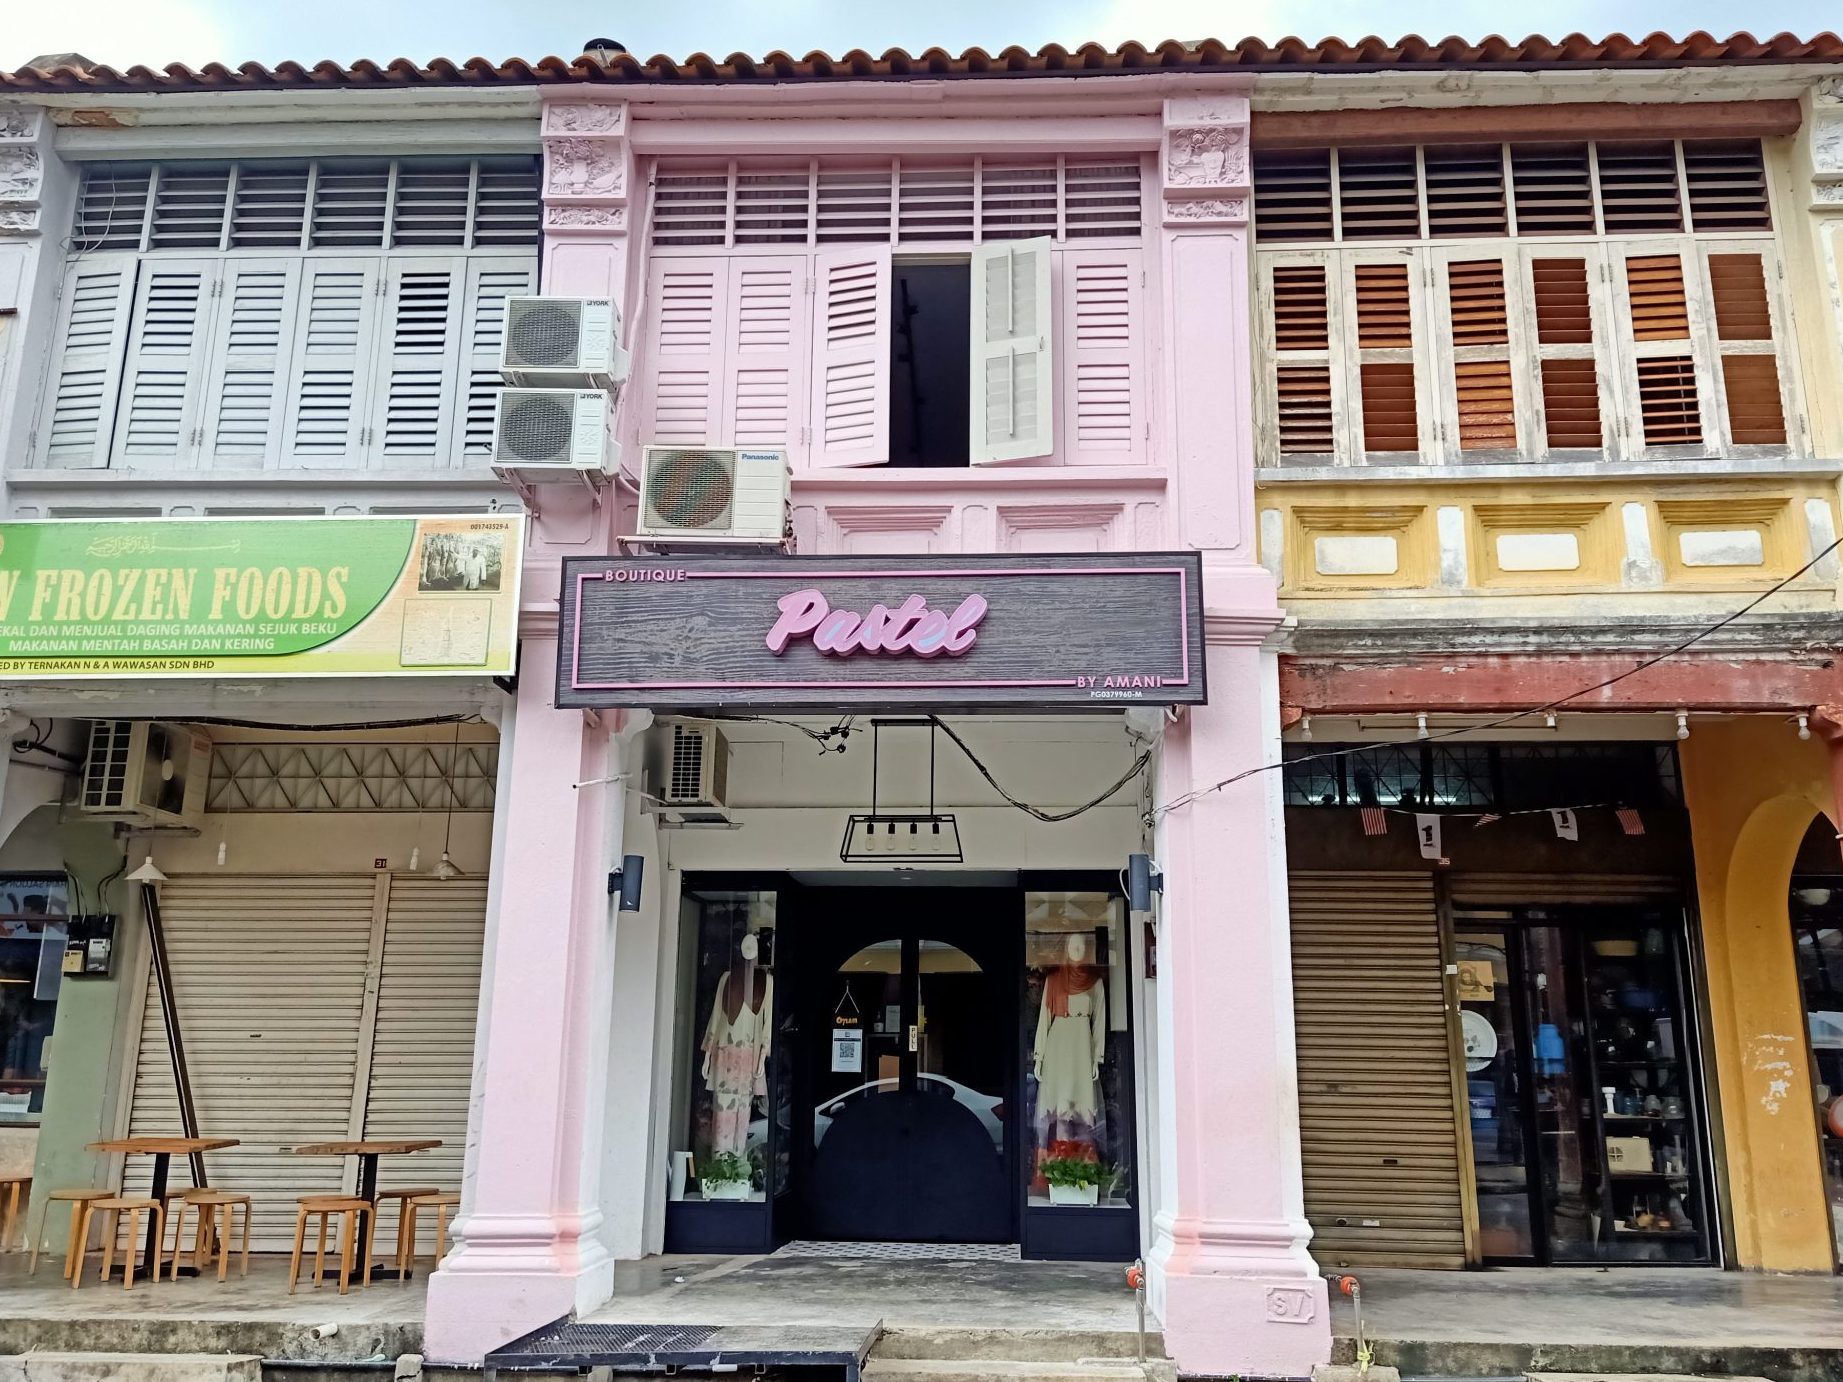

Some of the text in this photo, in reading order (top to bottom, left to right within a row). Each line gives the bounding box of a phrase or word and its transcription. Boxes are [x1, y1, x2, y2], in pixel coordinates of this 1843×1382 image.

[741, 453, 779, 461] Panasonic
[605, 569, 686, 582] BOUTIQUE
[28, 568, 198, 621] FROZEN
[208, 566, 349, 620] FOODS
[29, 625, 58, 637] DAN
[62, 625, 123, 637] MENJUAL
[127, 624, 180, 636] DAGING
[184, 624, 255, 636] MAKANAN
[258, 623, 298, 635] SEJUK
[301, 623, 336, 634] BEKU
[765, 588, 988, 659] Pastel
[9, 638, 275, 652] MAKANAN MENTAH BASAH DAN KERING
[13, 662, 26, 670] BY
[28, 661, 82, 670] TERNAKAN
[83, 661, 91, 669] N
[93, 661, 101, 669] &
[102, 661, 110, 669] A
[112, 661, 166, 669] WAWASAN
[169, 660, 190, 669] SDN
[192, 660, 215, 669] BHD
[1077, 675, 1161, 688] BY AMANI
